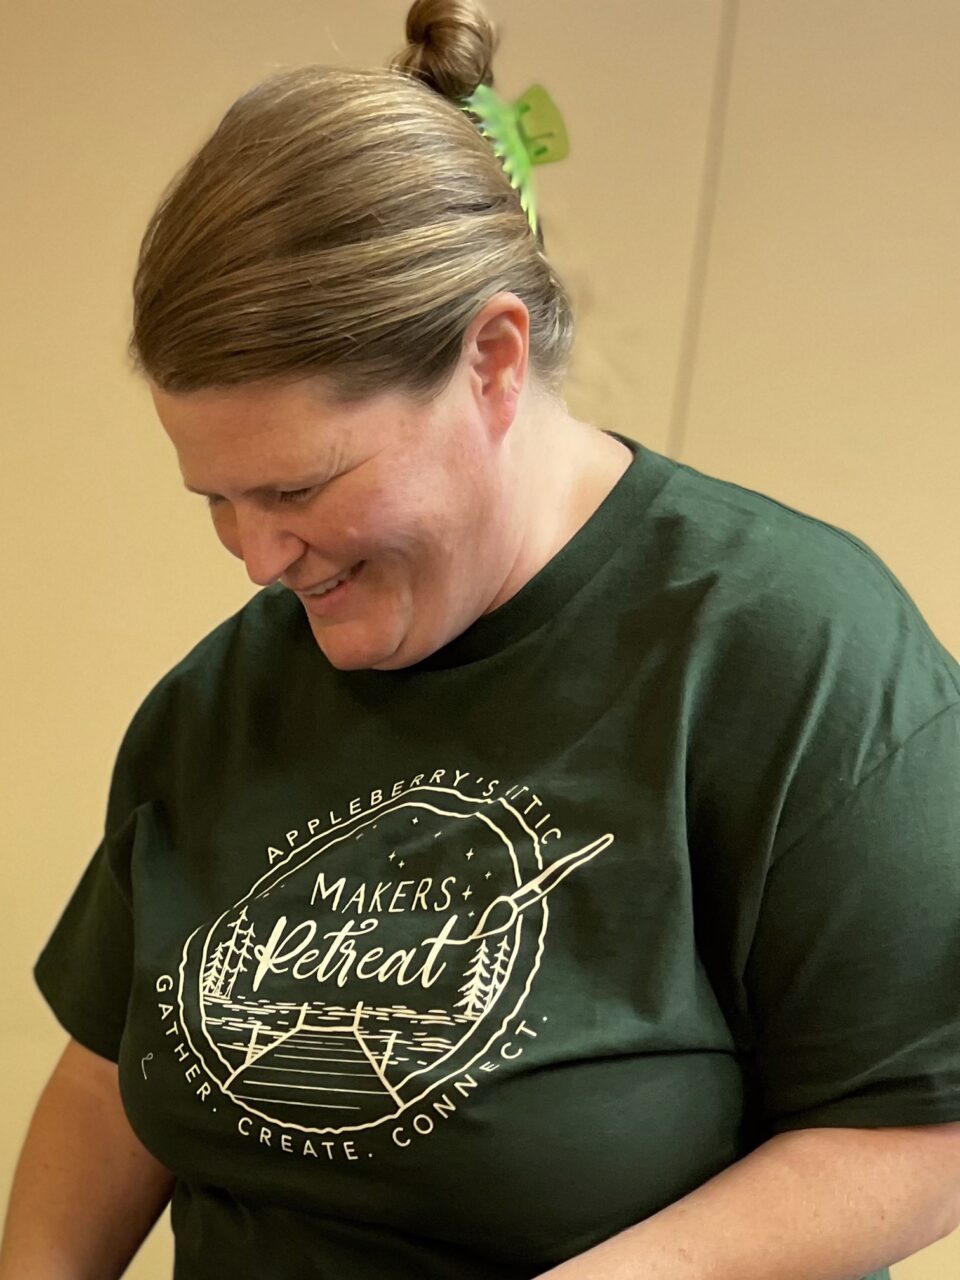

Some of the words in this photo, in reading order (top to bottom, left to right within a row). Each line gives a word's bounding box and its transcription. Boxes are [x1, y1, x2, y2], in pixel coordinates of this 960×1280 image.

[266, 768, 500, 865] APPLEBERRY'S
[310, 872, 457, 914] MAKERS
[253, 915, 462, 992] Retreat
[236, 1116, 373, 1161] CREATE.
